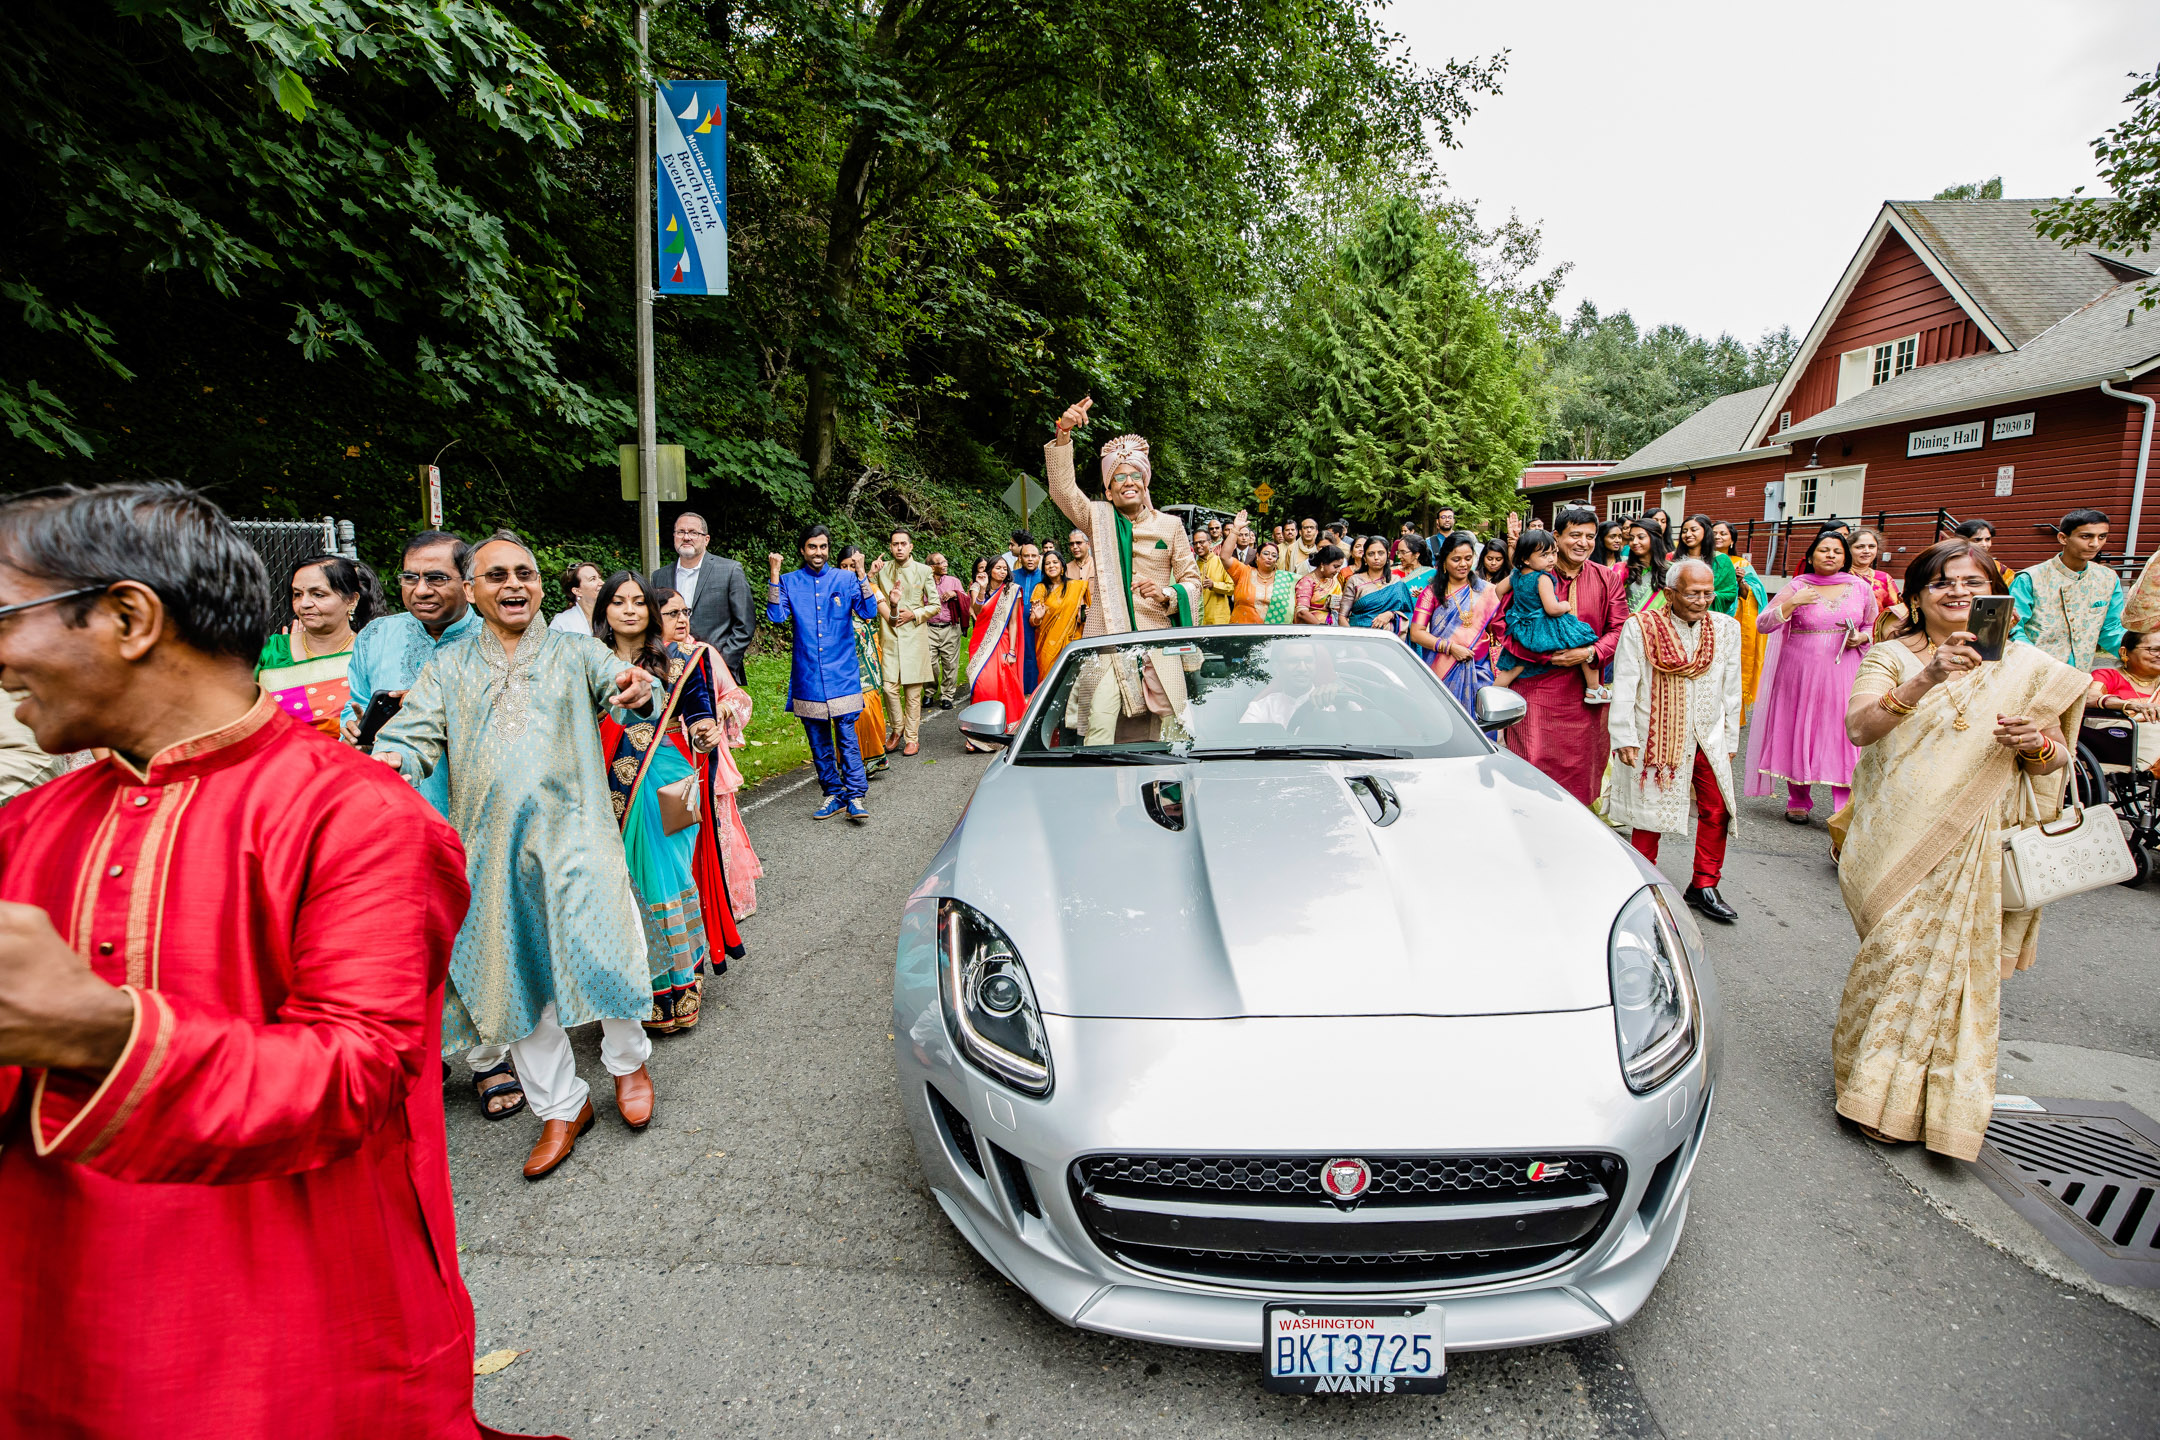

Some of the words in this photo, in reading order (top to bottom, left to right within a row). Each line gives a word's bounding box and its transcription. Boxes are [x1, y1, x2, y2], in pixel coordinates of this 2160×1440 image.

[686, 134, 707, 170] Marina
[703, 168, 723, 205] District
[662, 153, 688, 191] Event
[683, 191, 704, 235] Center
[676, 150, 702, 193] Beach
[696, 195, 717, 229] Park
[1913, 435, 1950, 451] Dining
[1953, 428, 1979, 445] Hall
[1995, 420, 2022, 435] 22030
[2023, 418, 2031, 430] B
[1279, 1318, 1375, 1331] WASHINGTON
[1277, 1333, 1432, 1376] BKT3725
[1314, 1375, 1396, 1394] AVANTS
